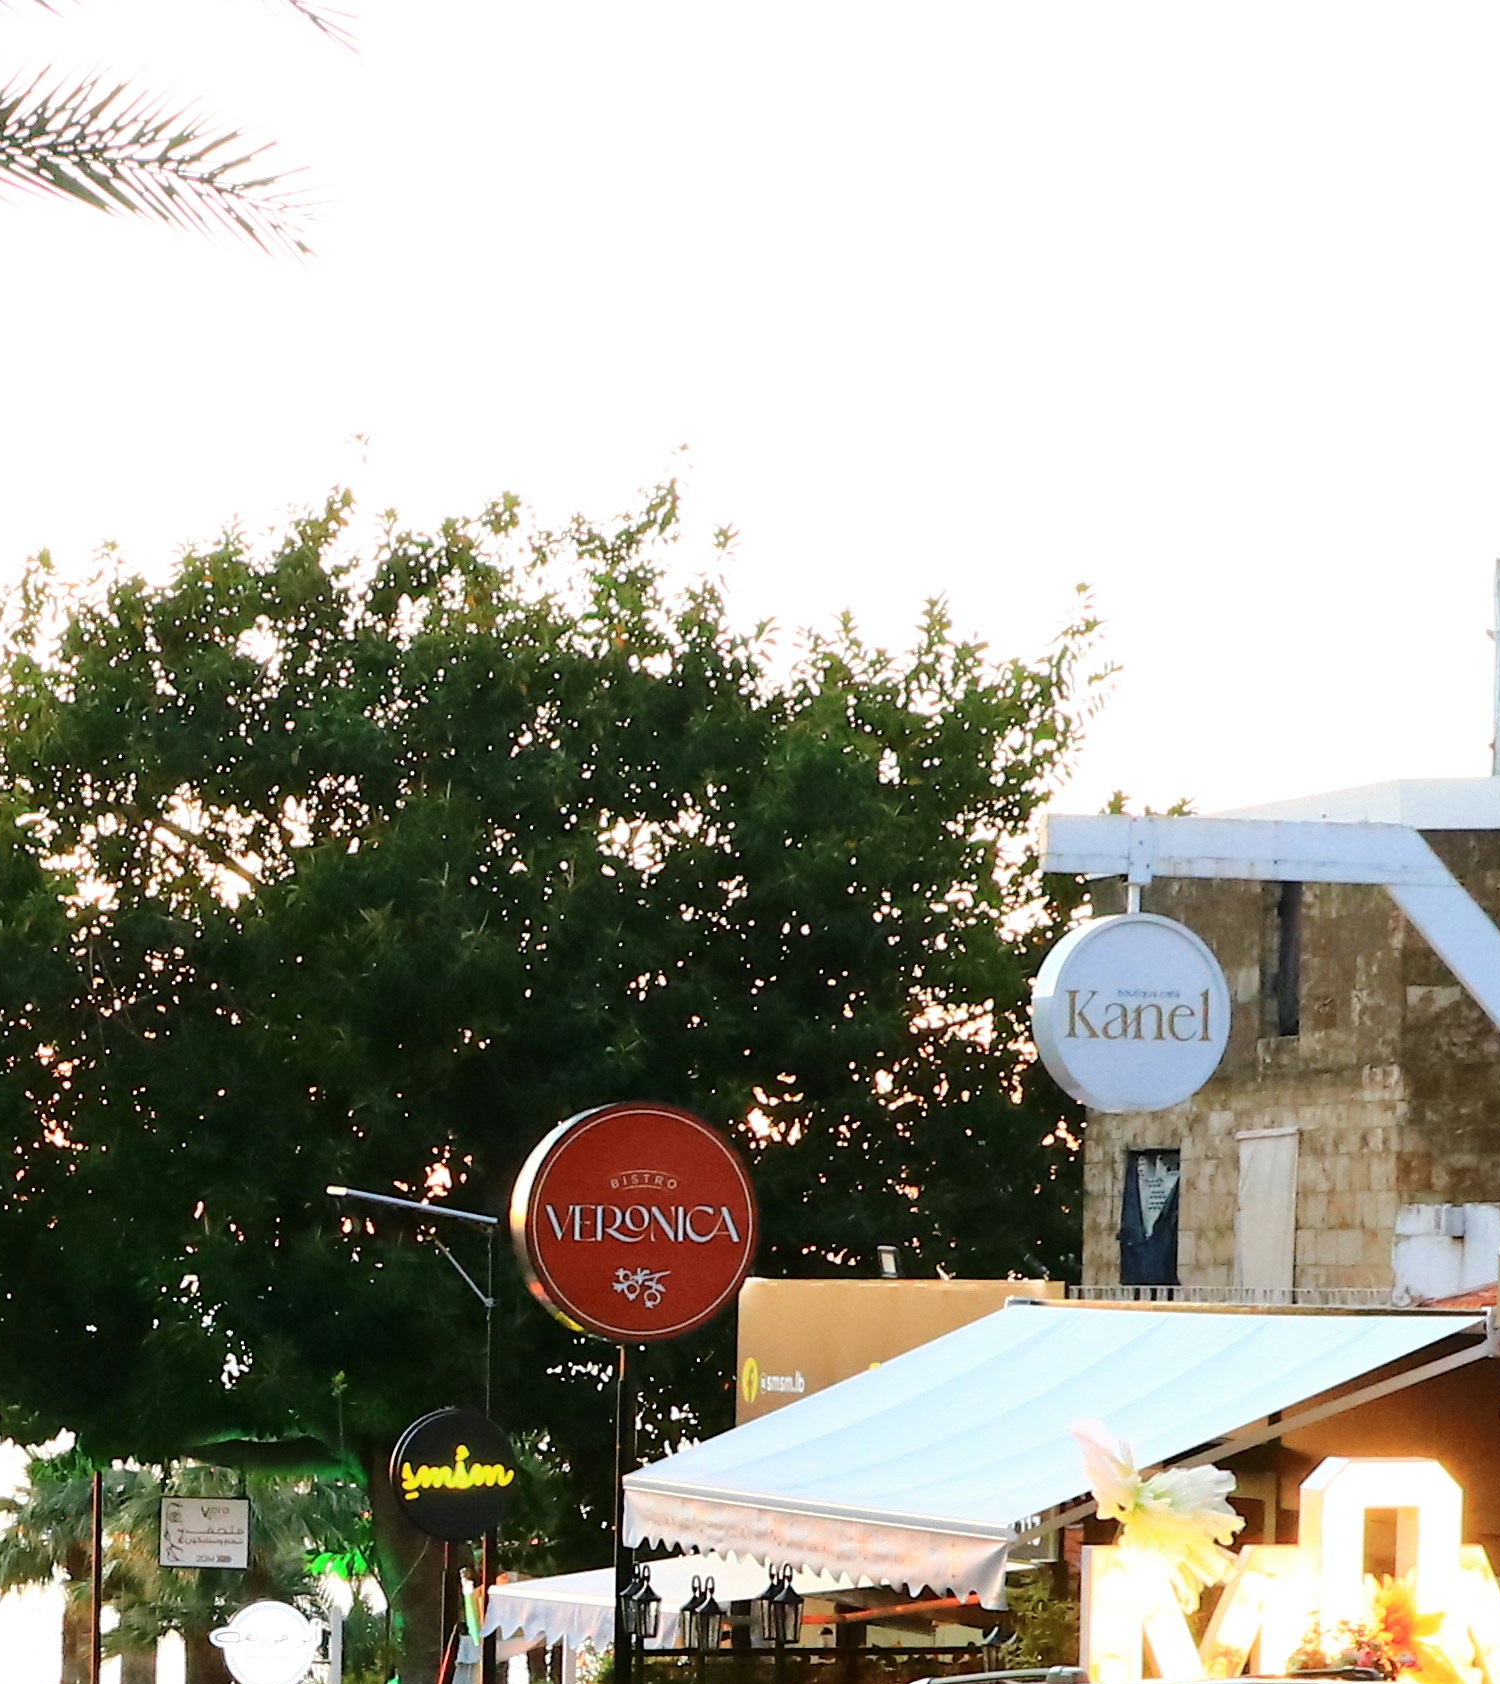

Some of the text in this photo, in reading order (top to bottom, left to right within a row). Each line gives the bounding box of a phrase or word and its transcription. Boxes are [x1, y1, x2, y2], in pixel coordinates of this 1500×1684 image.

[1064, 988, 1212, 1042] Kanel
[610, 1174, 678, 1191] BISTRO
[545, 1204, 741, 1243] VERONICA
